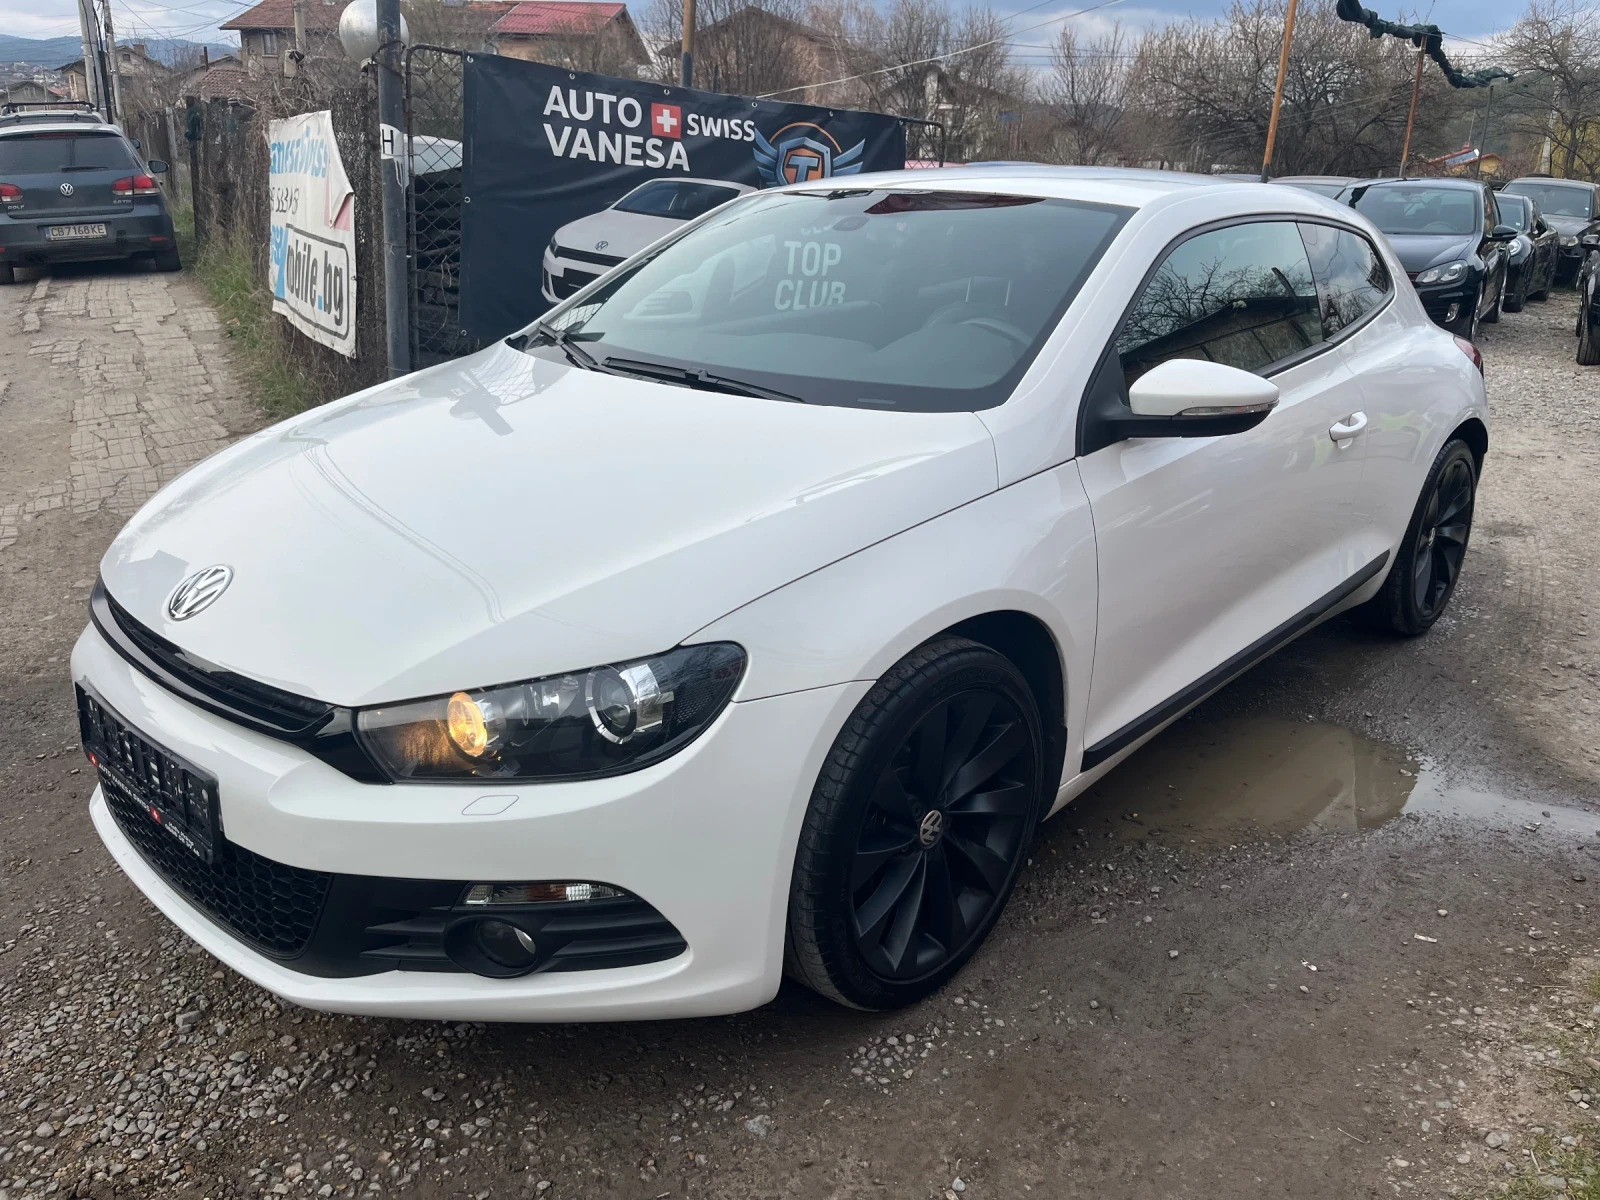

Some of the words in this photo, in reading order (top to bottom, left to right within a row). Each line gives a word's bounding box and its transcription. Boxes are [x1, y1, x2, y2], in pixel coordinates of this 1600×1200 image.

[543, 85, 643, 128] AUTO
[686, 113, 755, 142] SWISS
[543, 123, 690, 172] VANESA
[784, 240, 842, 276] TOP
[774, 279, 846, 311] CLUB
